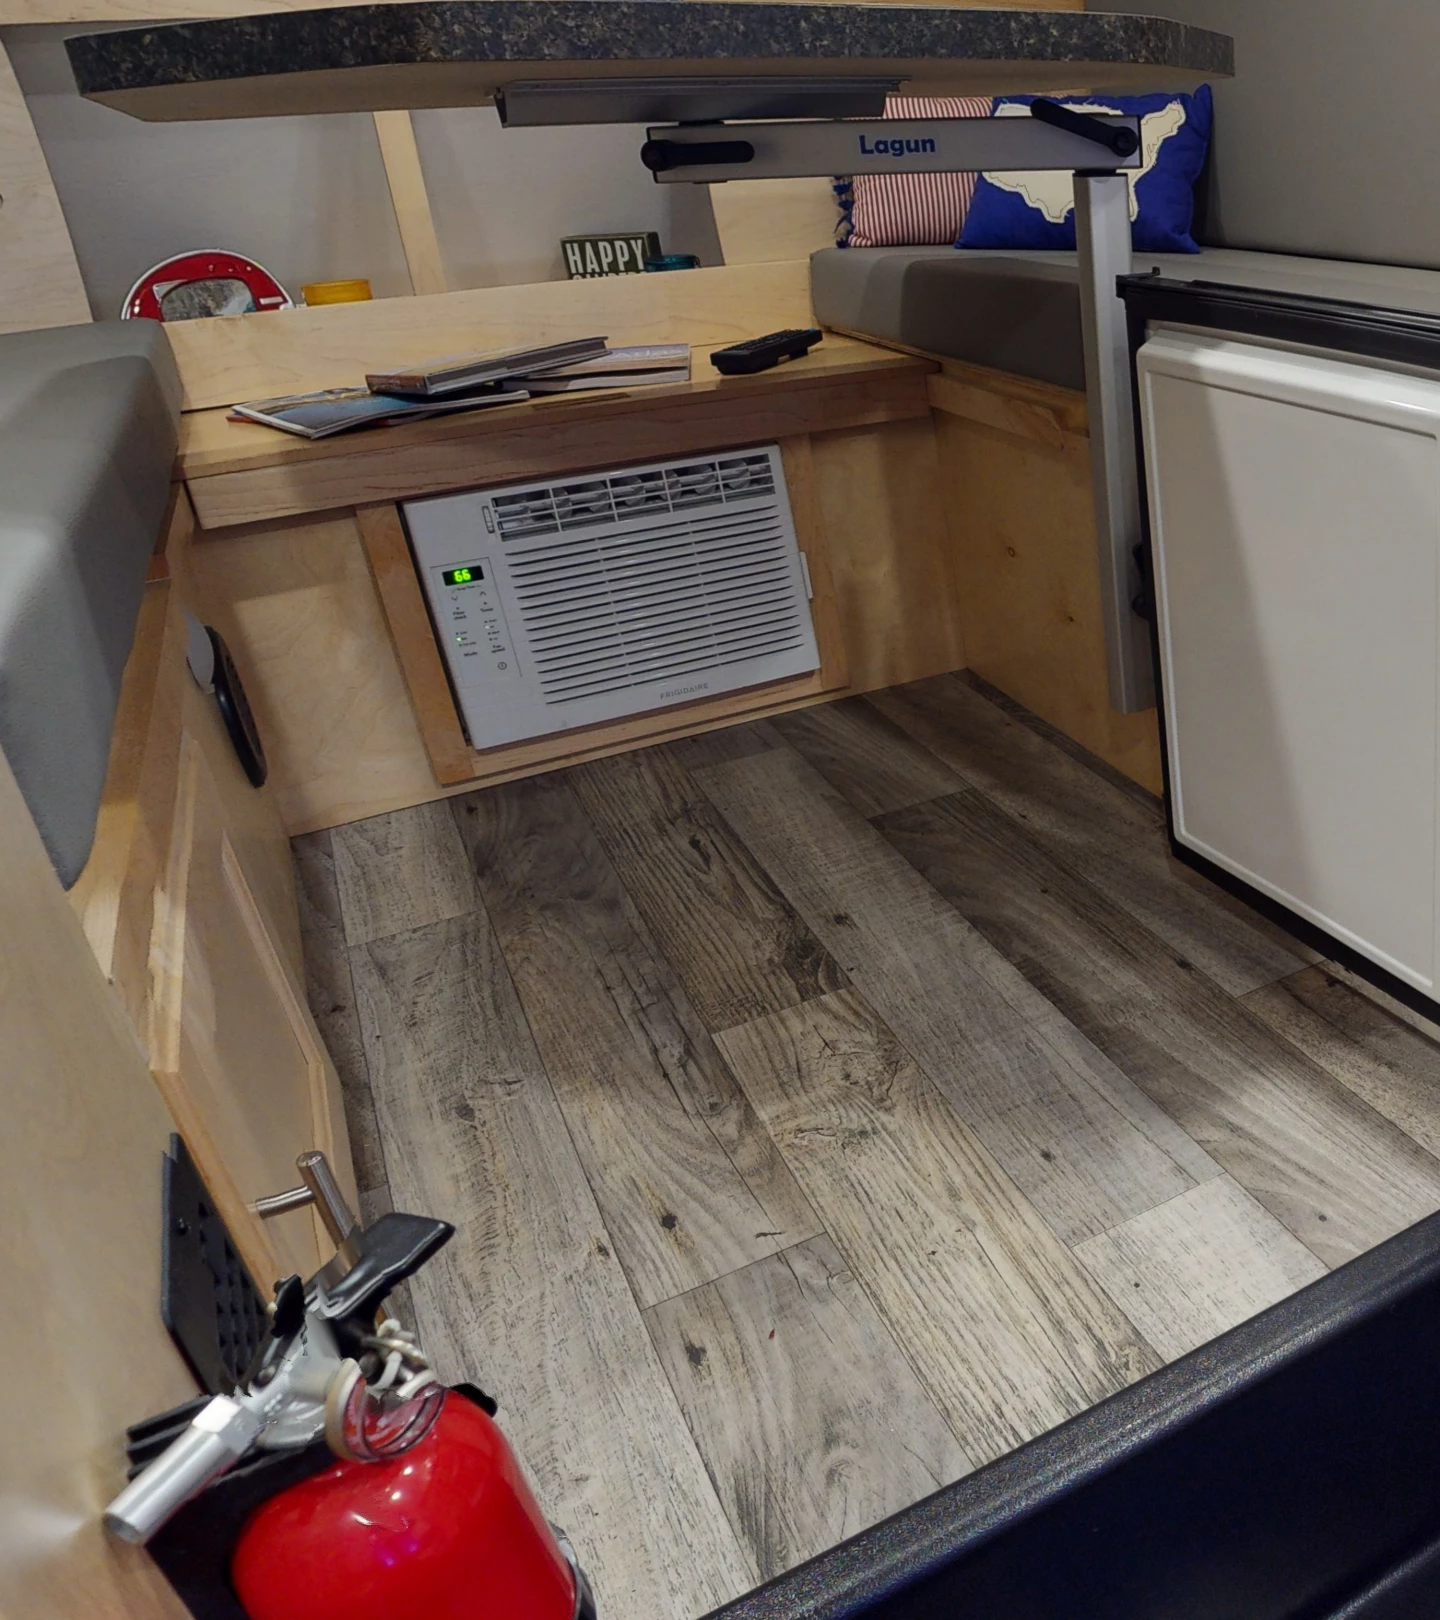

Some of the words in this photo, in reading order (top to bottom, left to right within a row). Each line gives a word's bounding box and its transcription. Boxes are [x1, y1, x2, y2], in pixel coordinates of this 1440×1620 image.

[859, 134, 936, 157] Lagun
[565, 239, 645, 274] HAPPY
[453, 568, 472, 583] 66
[660, 682, 709, 700] FRIGIDAIRE
